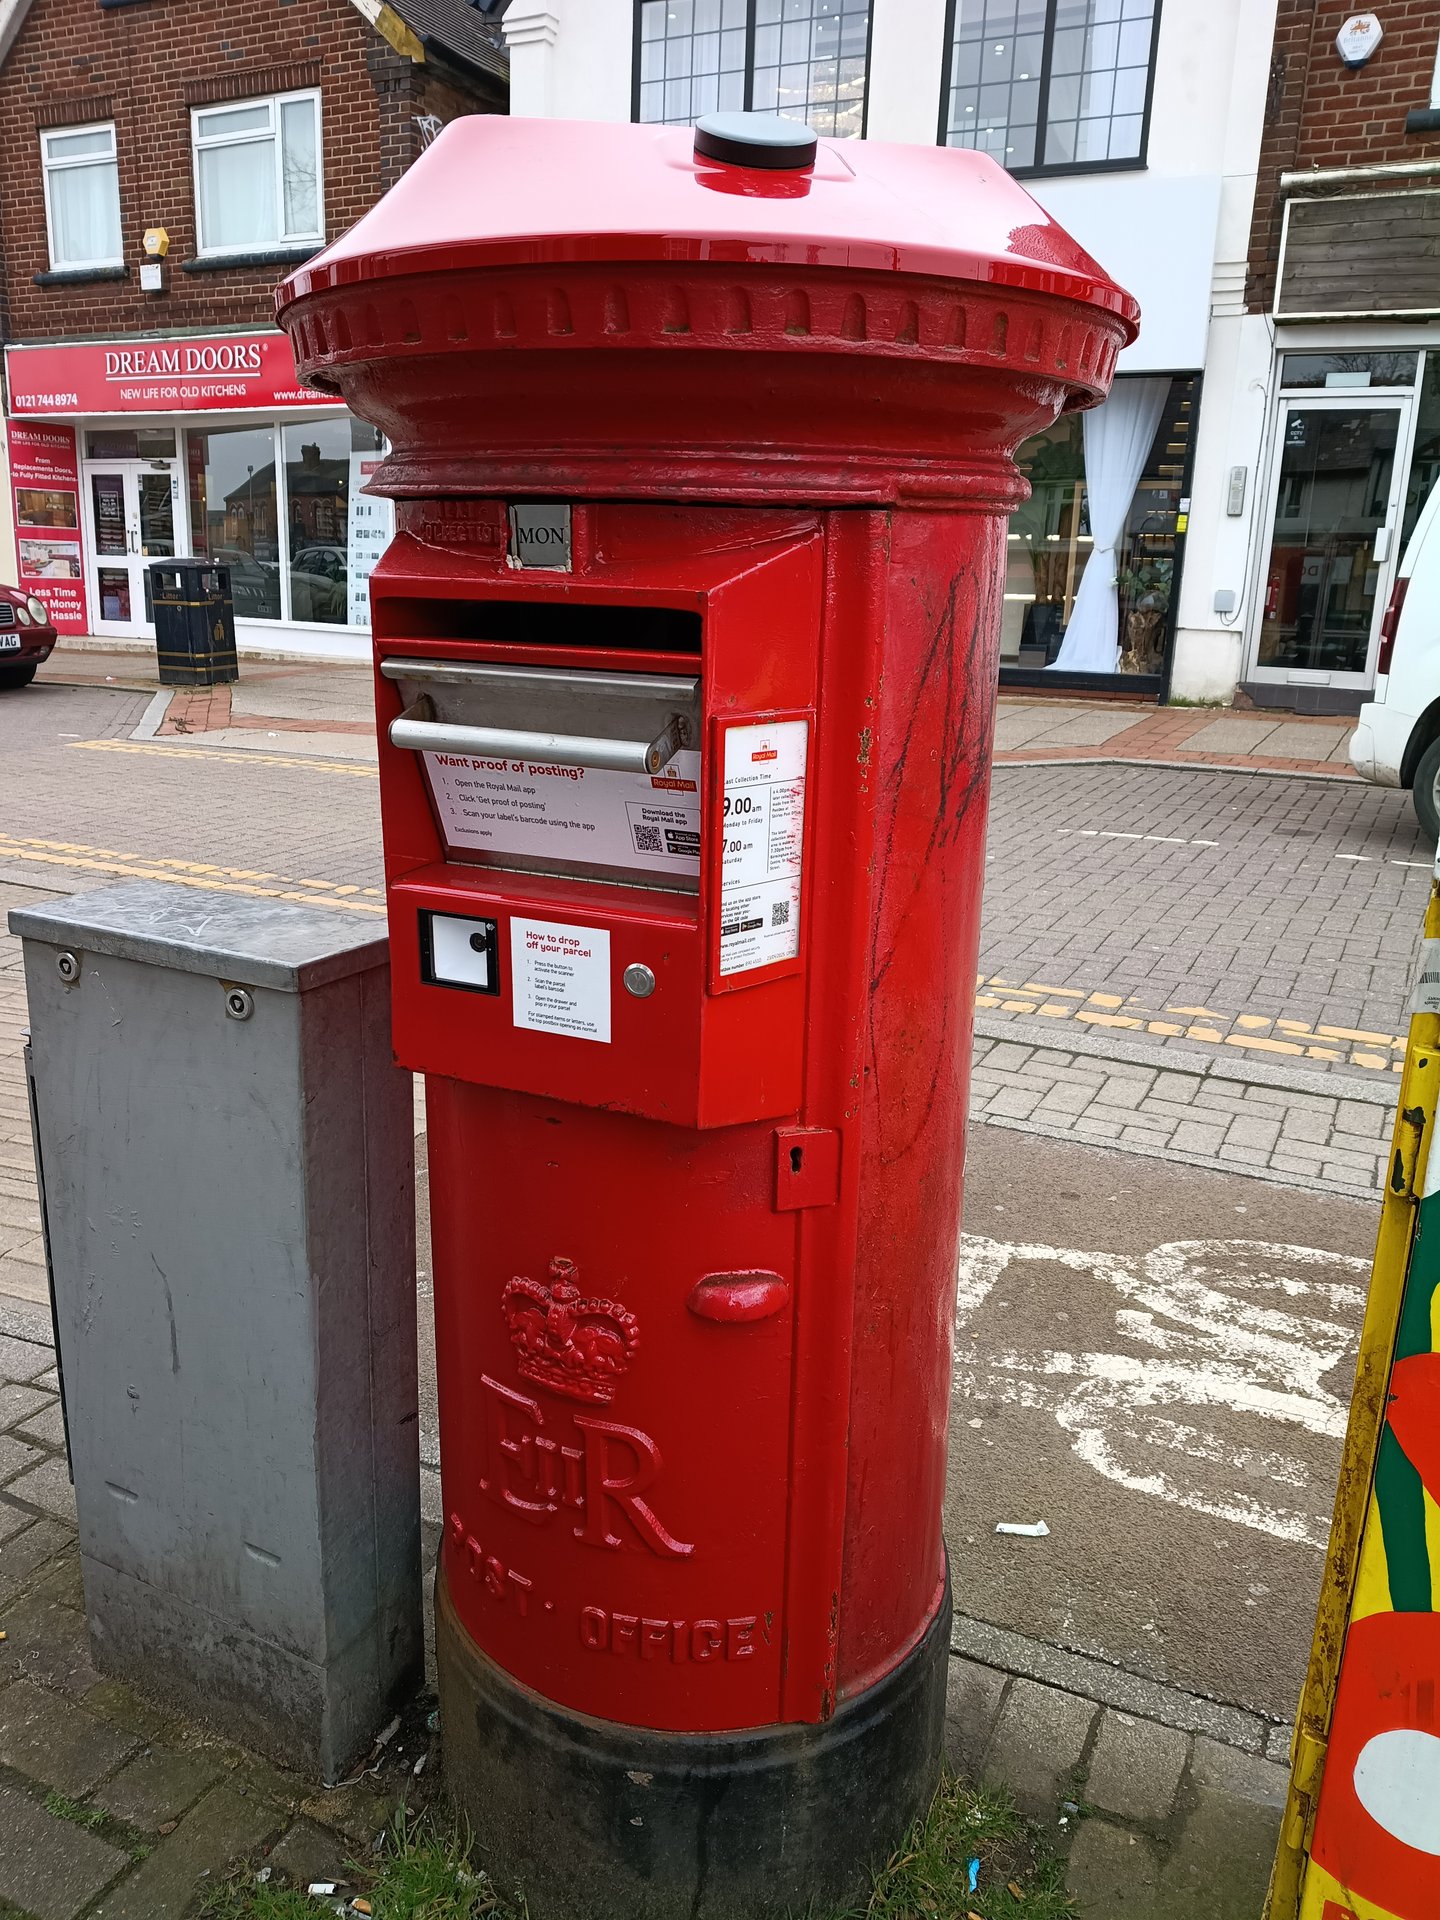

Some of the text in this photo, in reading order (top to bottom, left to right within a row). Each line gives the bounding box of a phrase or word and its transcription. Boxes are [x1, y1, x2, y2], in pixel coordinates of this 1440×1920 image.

[105, 349, 180, 375] DREAM
[120, 384, 246, 400] NEW LIFE FOR OLD KITCHENS
[15, 393, 78, 407] 0121 744 8974
[11, 431, 40, 441] DREAM
[35, 456, 50, 464] From
[13, 463, 53, 472] Replacements
[518, 527, 564, 544] MON
[29, 587, 76, 597] Less Time
[50, 599, 81, 610] Money
[51, 611, 82, 620] Hassle
[435, 754, 585, 781] Want proof of posting?
[442, 777, 536, 795] 1. Open the Royal Mail app
[653, 779, 694, 789] Royal Mail
[459, 794, 475, 802] Click
[492, 798, 510, 806] proof
[641, 808, 674, 817] Download
[724, 797, 751, 817] 9.00
[463, 809, 480, 818] Scan
[481, 811, 496, 820] your
[520, 815, 547, 825] barcode
[549, 819, 568, 829] using
[569, 821, 581, 829] the
[582, 823, 595, 831] app
[642, 814, 660, 822] Royal
[748, 817, 763, 825] Friday
[454, 826, 479, 835] Exclusions
[526, 931, 580, 947] How to drop
[526, 941, 591, 957] off your parcel
[579, 1606, 758, 1662] OFFICE
